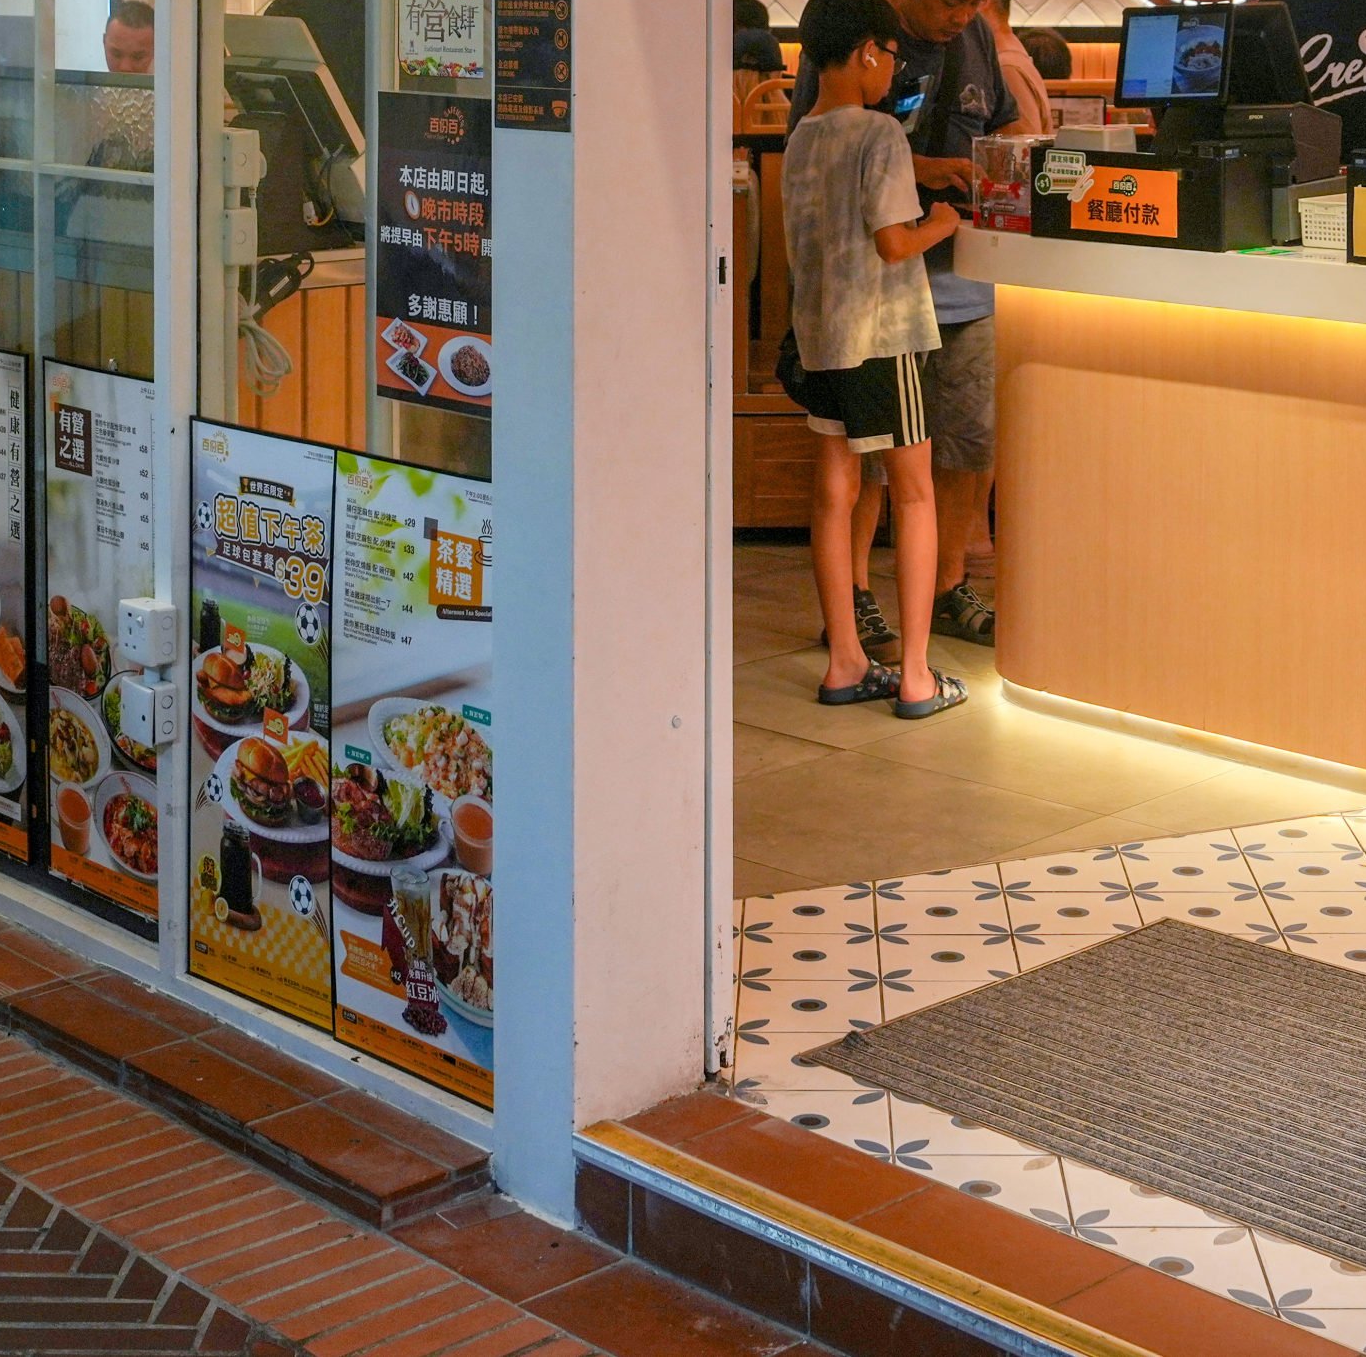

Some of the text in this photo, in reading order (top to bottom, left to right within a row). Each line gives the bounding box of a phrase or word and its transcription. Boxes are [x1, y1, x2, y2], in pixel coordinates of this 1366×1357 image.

[430, 117, 459, 135] 百份百
[421, 196, 484, 228] 晚市時段
[1087, 199, 1160, 226] 餐廳付款
[59, 408, 85, 437] 有營
[59, 435, 85, 463] 之選
[9, 389, 22, 541] 健康有營之選
[250, 481, 285, 500] 世界盃限定
[215, 495, 325, 555] 超值下午茶
[404, 518, 416, 528] $29
[222, 541, 275, 571] 足球包套餐
[403, 544, 415, 555] $33
[436, 536, 473, 571] 茶餐
[275, 556, 326, 604] $39
[402, 571, 414, 582] $42
[435, 567, 473, 601] 精選
[402, 603, 413, 614] $44
[401, 635, 412, 646] $47
[406, 981, 440, 1004] 紅豆冰
